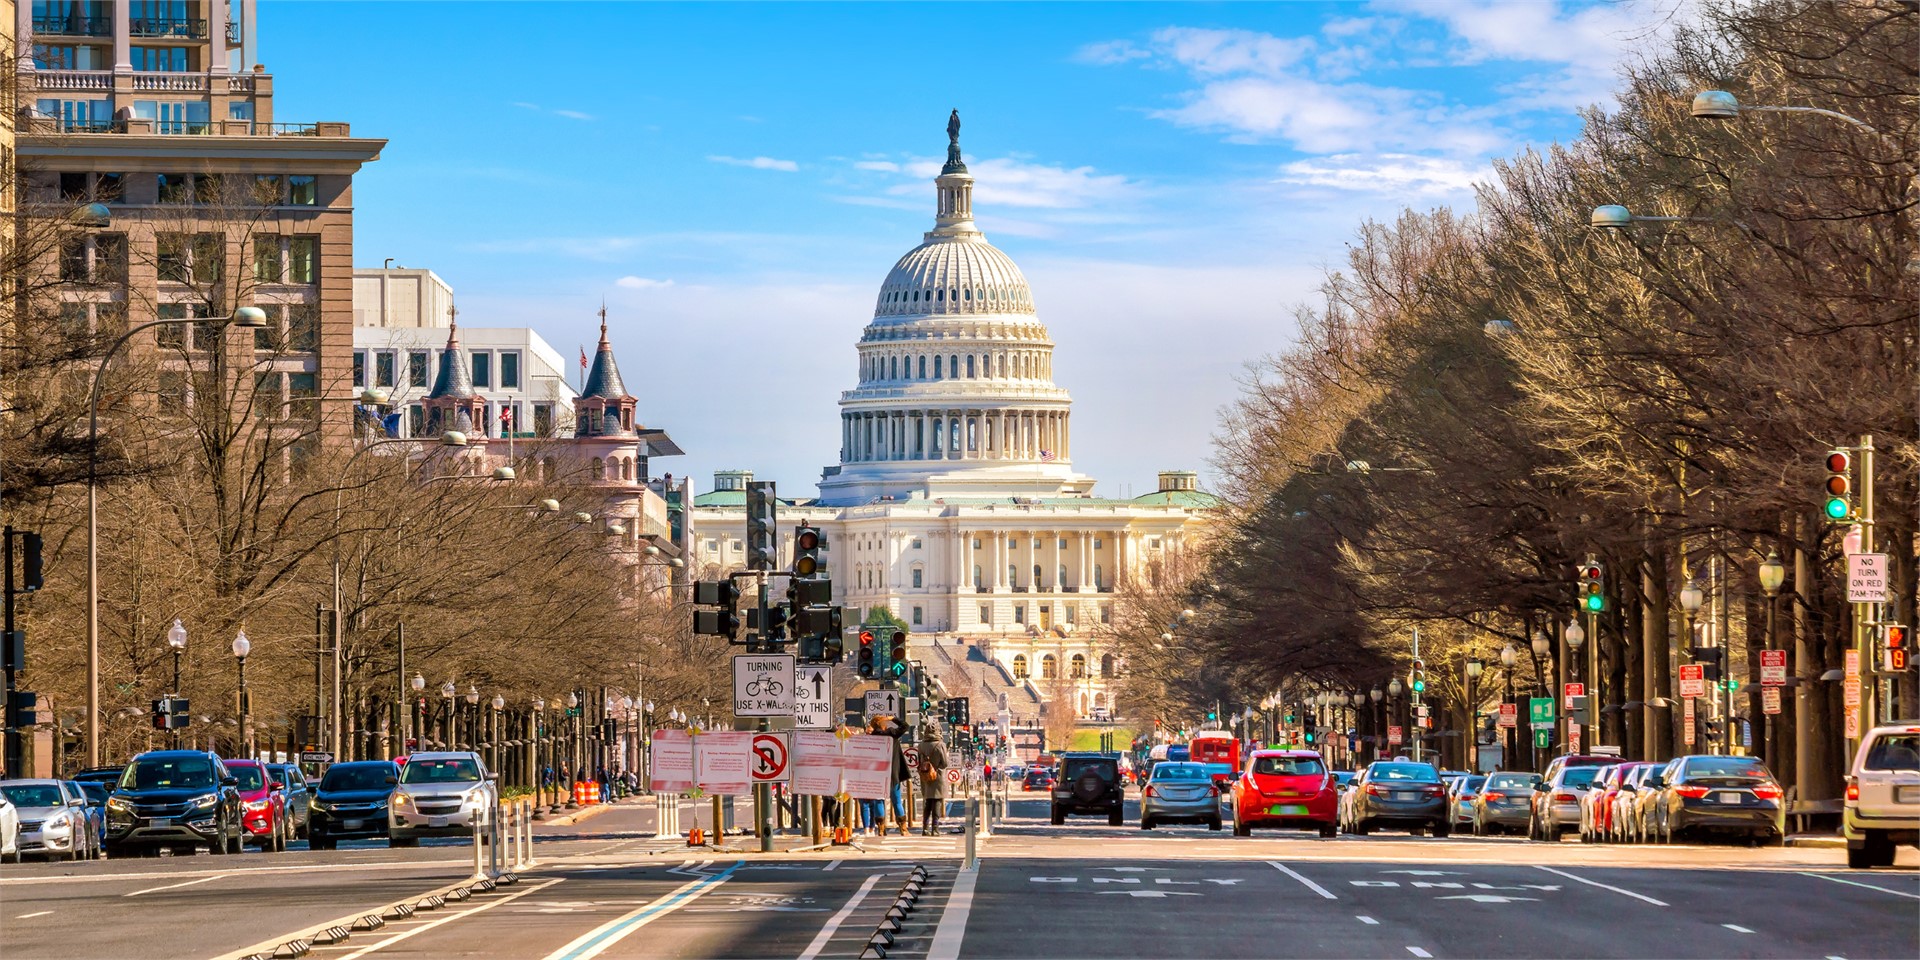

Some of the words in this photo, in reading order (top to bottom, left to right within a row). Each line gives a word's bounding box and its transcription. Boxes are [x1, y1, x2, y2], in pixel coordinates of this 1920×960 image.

[1861, 558, 1874, 566] NO
[1857, 569, 1878, 577] TURN
[1852, 579, 1864, 587] ON
[1850, 590, 1886, 598] 7AM-7PM
[746, 661, 783, 672] TURNING
[795, 671, 806, 681] RU
[736, 700, 753, 710] USE
[757, 700, 791, 710] X-WAL
[796, 702, 807, 713] EY
[810, 702, 829, 713] THIS
[797, 715, 815, 725] NAL
[1030, 876, 1245, 885] ONLY
[1349, 880, 1563, 891] ONLY
